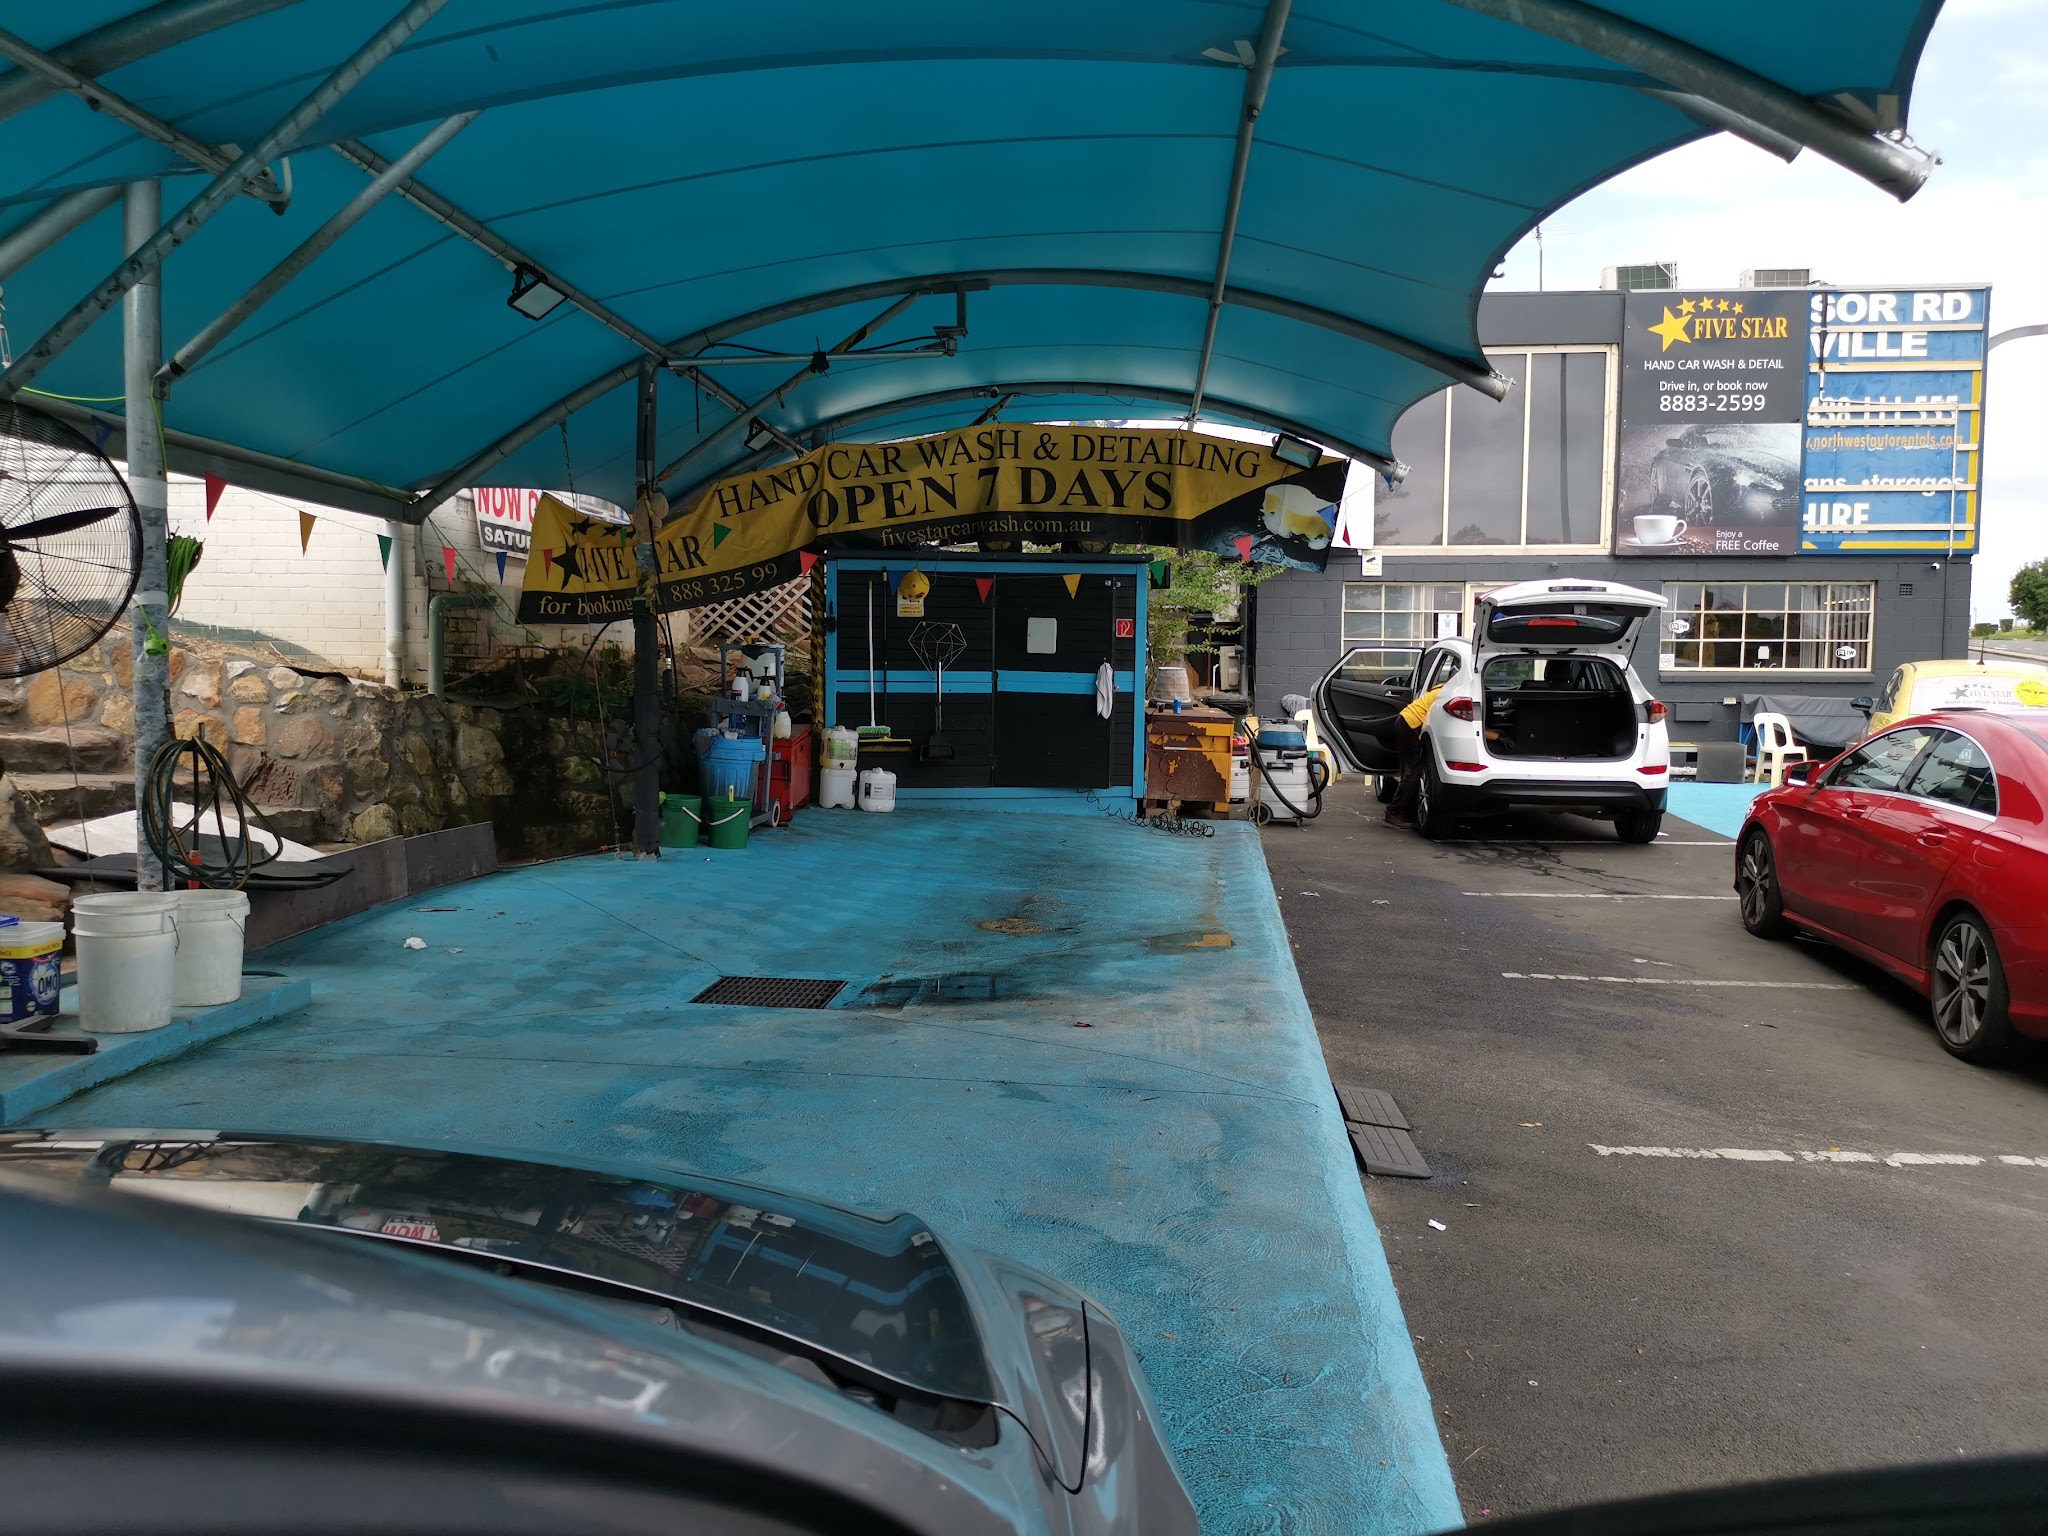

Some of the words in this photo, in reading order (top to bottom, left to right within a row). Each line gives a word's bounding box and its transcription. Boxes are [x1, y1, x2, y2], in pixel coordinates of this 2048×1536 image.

[1912, 292, 1972, 321] RD
[1694, 318, 1737, 339] FIVE
[1741, 317, 1788, 338] STAR
[1644, 360, 1675, 370] HAND
[1678, 360, 1700, 370] CAR
[1702, 359, 1735, 370] WASH
[1738, 359, 1746, 369] &
[1749, 359, 1784, 369] DETAIL
[1659, 381, 1685, 391] Drive
[1688, 381, 1700, 392] in,
[1703, 383, 1714, 391] or
[1717, 380, 1742, 391] book
[1745, 382, 1768, 391] now
[1659, 394, 1766, 412] 8883-2599
[715, 462, 820, 518] HAND
[827, 447, 908, 481] CAR
[914, 429, 1022, 469] WASH
[1033, 433, 1060, 461] &
[1072, 434, 1262, 479] DETAILING
[807, 472, 959, 528] OPEN
[977, 466, 1000, 507] 7
[1015, 466, 1173, 511] DAYS
[880, 515, 1092, 547] fivestarcarwash.com.au
[1716, 530, 1736, 539] Enjoy
[1716, 541, 1740, 551] FREE
[1743, 540, 1779, 551] Coffee
[539, 595, 571, 615] for
[670, 580, 705, 603] 888
[708, 572, 746, 595] 325
[751, 562, 778, 584] 99
[39, 975, 58, 995] OMO
